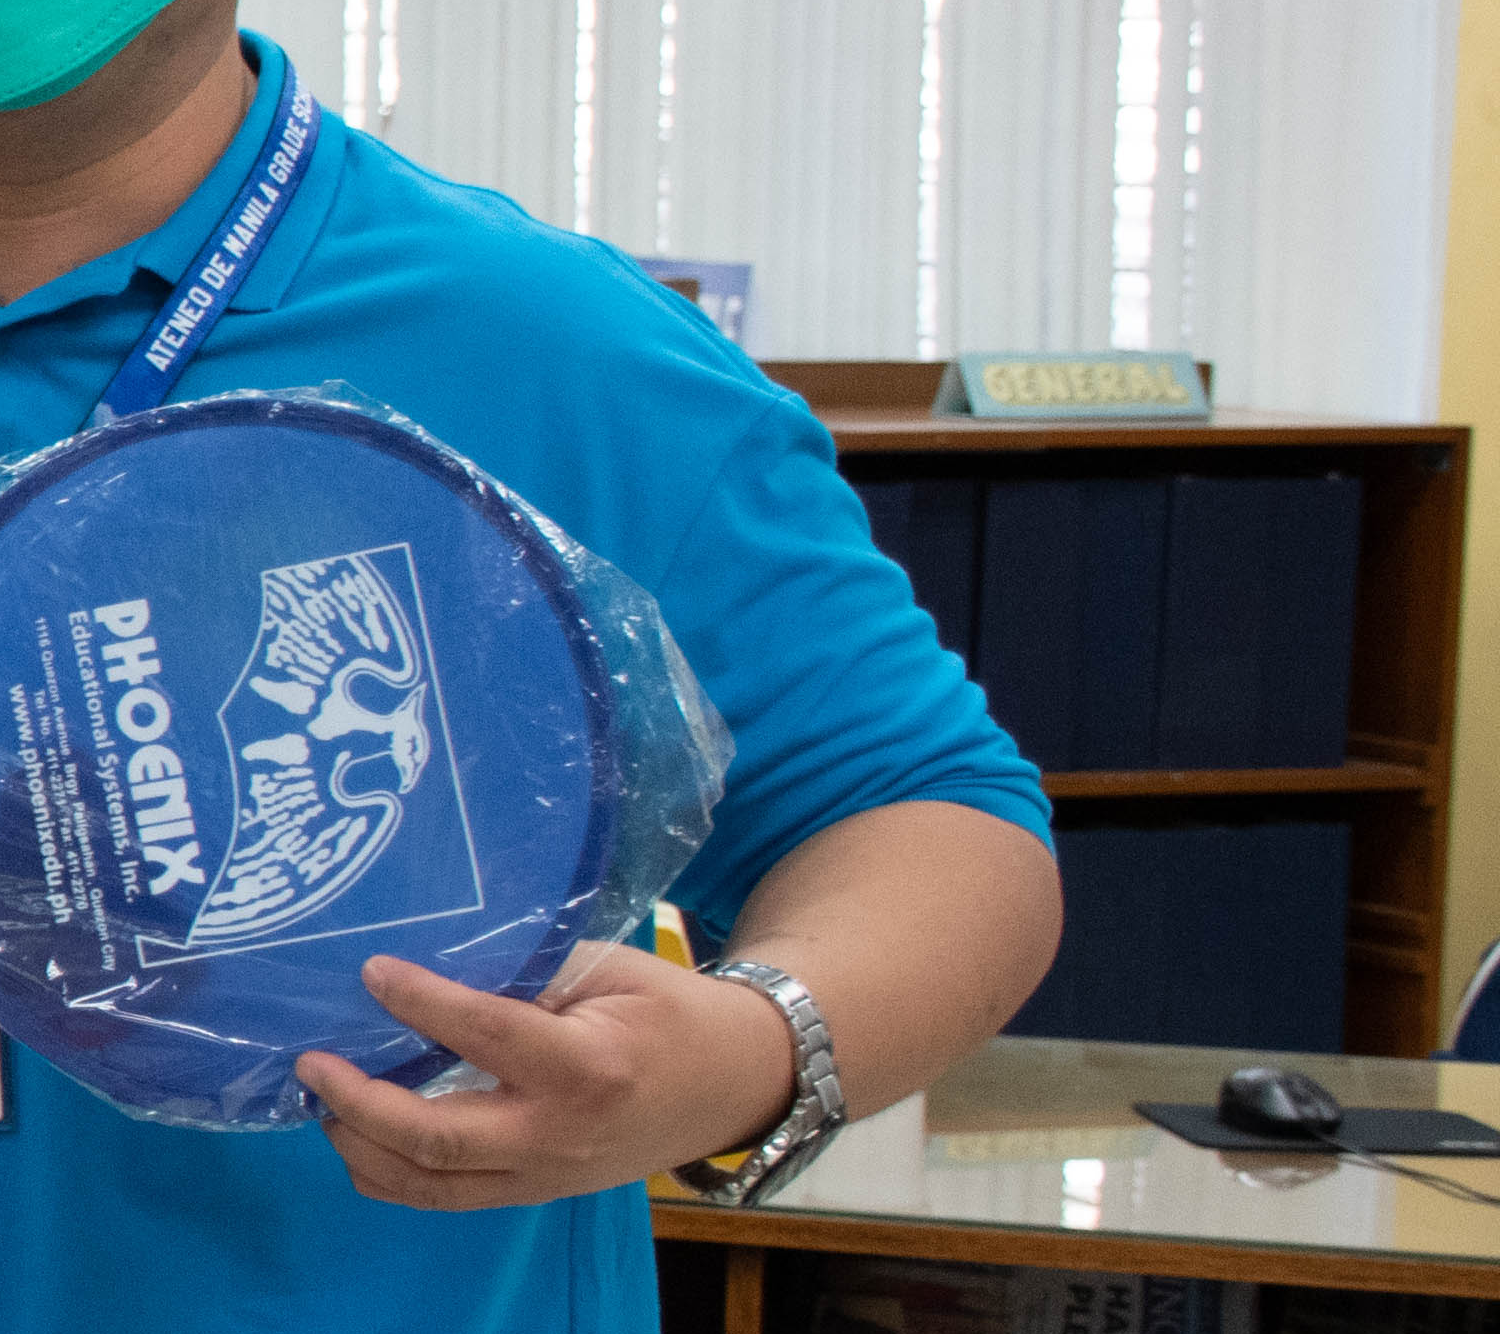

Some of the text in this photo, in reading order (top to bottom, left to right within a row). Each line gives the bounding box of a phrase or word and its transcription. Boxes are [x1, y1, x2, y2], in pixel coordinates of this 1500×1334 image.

[143, 285, 213, 372] ATENEO
[199, 252, 236, 291] DE
[221, 181, 280, 259] MANILA
[268, 117, 308, 185] GRADE
[983, 362, 1190, 408] GENERAL
[8, 683, 73, 925] www.phoenixedu.ph
[41, 651, 64, 704] Quezon
[88, 886, 110, 942] Quezon
[101, 943, 117, 972] City
[67, 609, 142, 904] Educational Systems, Inc.
[93, 598, 206, 897] PHOENIX
